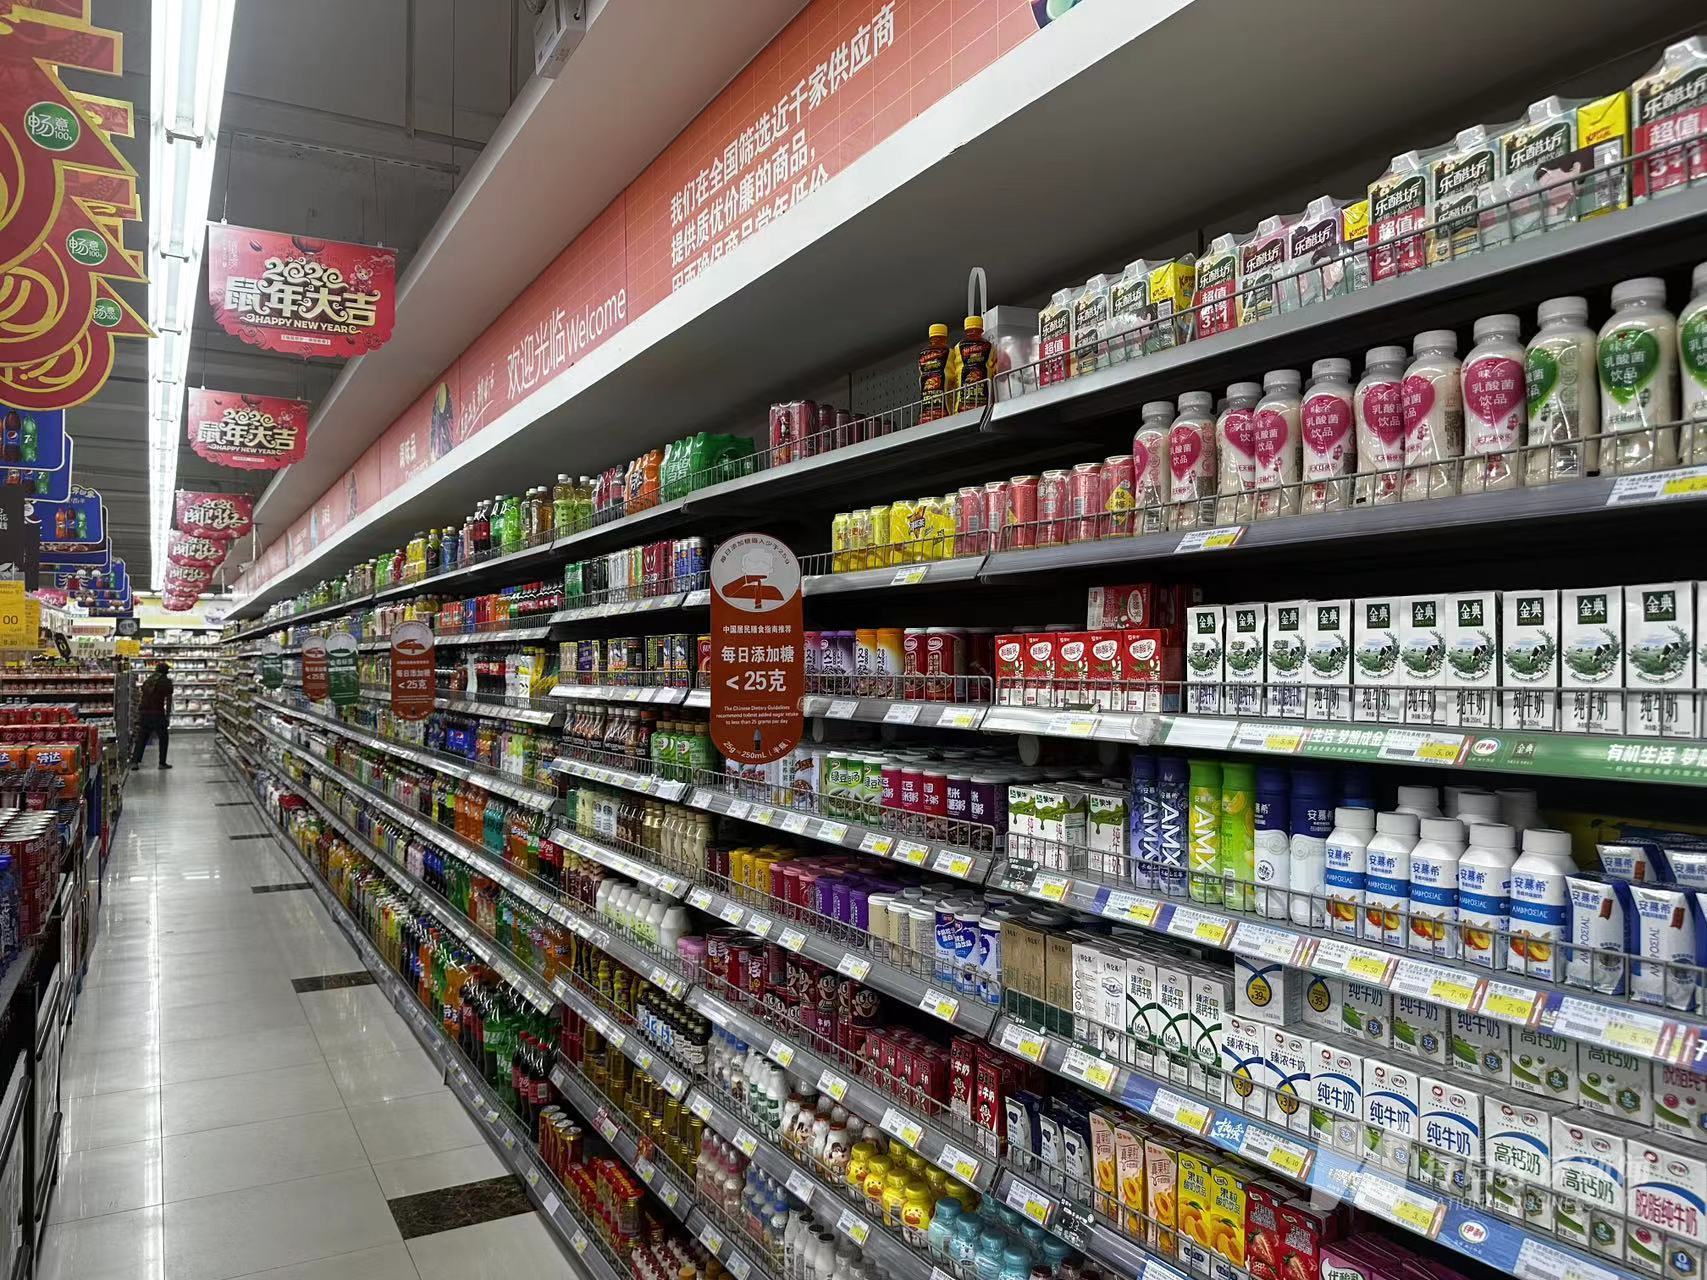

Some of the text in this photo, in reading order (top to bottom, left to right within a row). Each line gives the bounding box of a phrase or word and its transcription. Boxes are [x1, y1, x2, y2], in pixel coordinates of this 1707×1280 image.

[670, 1, 896, 229] 我们在全国筛选近千家供应商
[1648, 113, 1701, 144] 超值
[1378, 213, 1415, 242] 超值
[262, 257, 350, 290] 2020
[223, 274, 382, 328] 鼠年大吉
[255, 314, 349, 334] HAPPY NEW YEAR
[507, 287, 627, 401] 欢迎光临 Welcome
[1602, 350, 1645, 368] 乳酸菌
[1610, 366, 1638, 380] 饮品
[1471, 378, 1515, 393] 乳酸菌
[1477, 392, 1508, 406] 饮品
[222, 407, 277, 427] 2020
[1305, 413, 1340, 427] 乳酸菌
[197, 421, 299, 451] 鼠年大吉
[1310, 426, 1334, 439] 饮品
[1414, 602, 1436, 621] 金典
[1460, 602, 1482, 620] 金典
[1519, 600, 1543, 618] 金典
[1579, 598, 1604, 617] 金典
[1646, 593, 1673, 614] 金典
[1198, 614, 1216, 628] 金典
[1238, 611, 1255, 626] 金典
[1280, 609, 1298, 625] 金典
[1319, 607, 1339, 624] 金典
[1368, 605, 1390, 622] 金典
[721, 645, 796, 665] 每日添加糖
[1607, 743, 1676, 766] 有机生活
[1161, 801, 1182, 868] AMX
[1194, 804, 1217, 875] AMX
[1327, 847, 1353, 862] 安慕希
[1369, 854, 1396, 869] 安慕希
[1604, 856, 1632, 869] 安慕希
[1412, 862, 1440, 877] 安慕希
[1460, 868, 1487, 884] 安慕希
[1514, 876, 1546, 893] 安慕希
[1572, 889, 1601, 905] 安慕希
[1638, 900, 1672, 915] 安慕希
[1457, 1009, 1500, 1040] 纯牛奶
[1587, 1046, 1639, 1072] 高钙奶
[1317, 1081, 1355, 1115] 纯牛奶
[1369, 1099, 1411, 1136] 纯牛奶
[1426, 1120, 1471, 1157] 纯牛奶
[1493, 1142, 1541, 1177] 高钙奶
[1562, 1167, 1615, 1205] 高钙奶
[1635, 1188, 1698, 1238] 脱脂纯牛奶
[1463, 1226, 1485, 1240] 伊利
